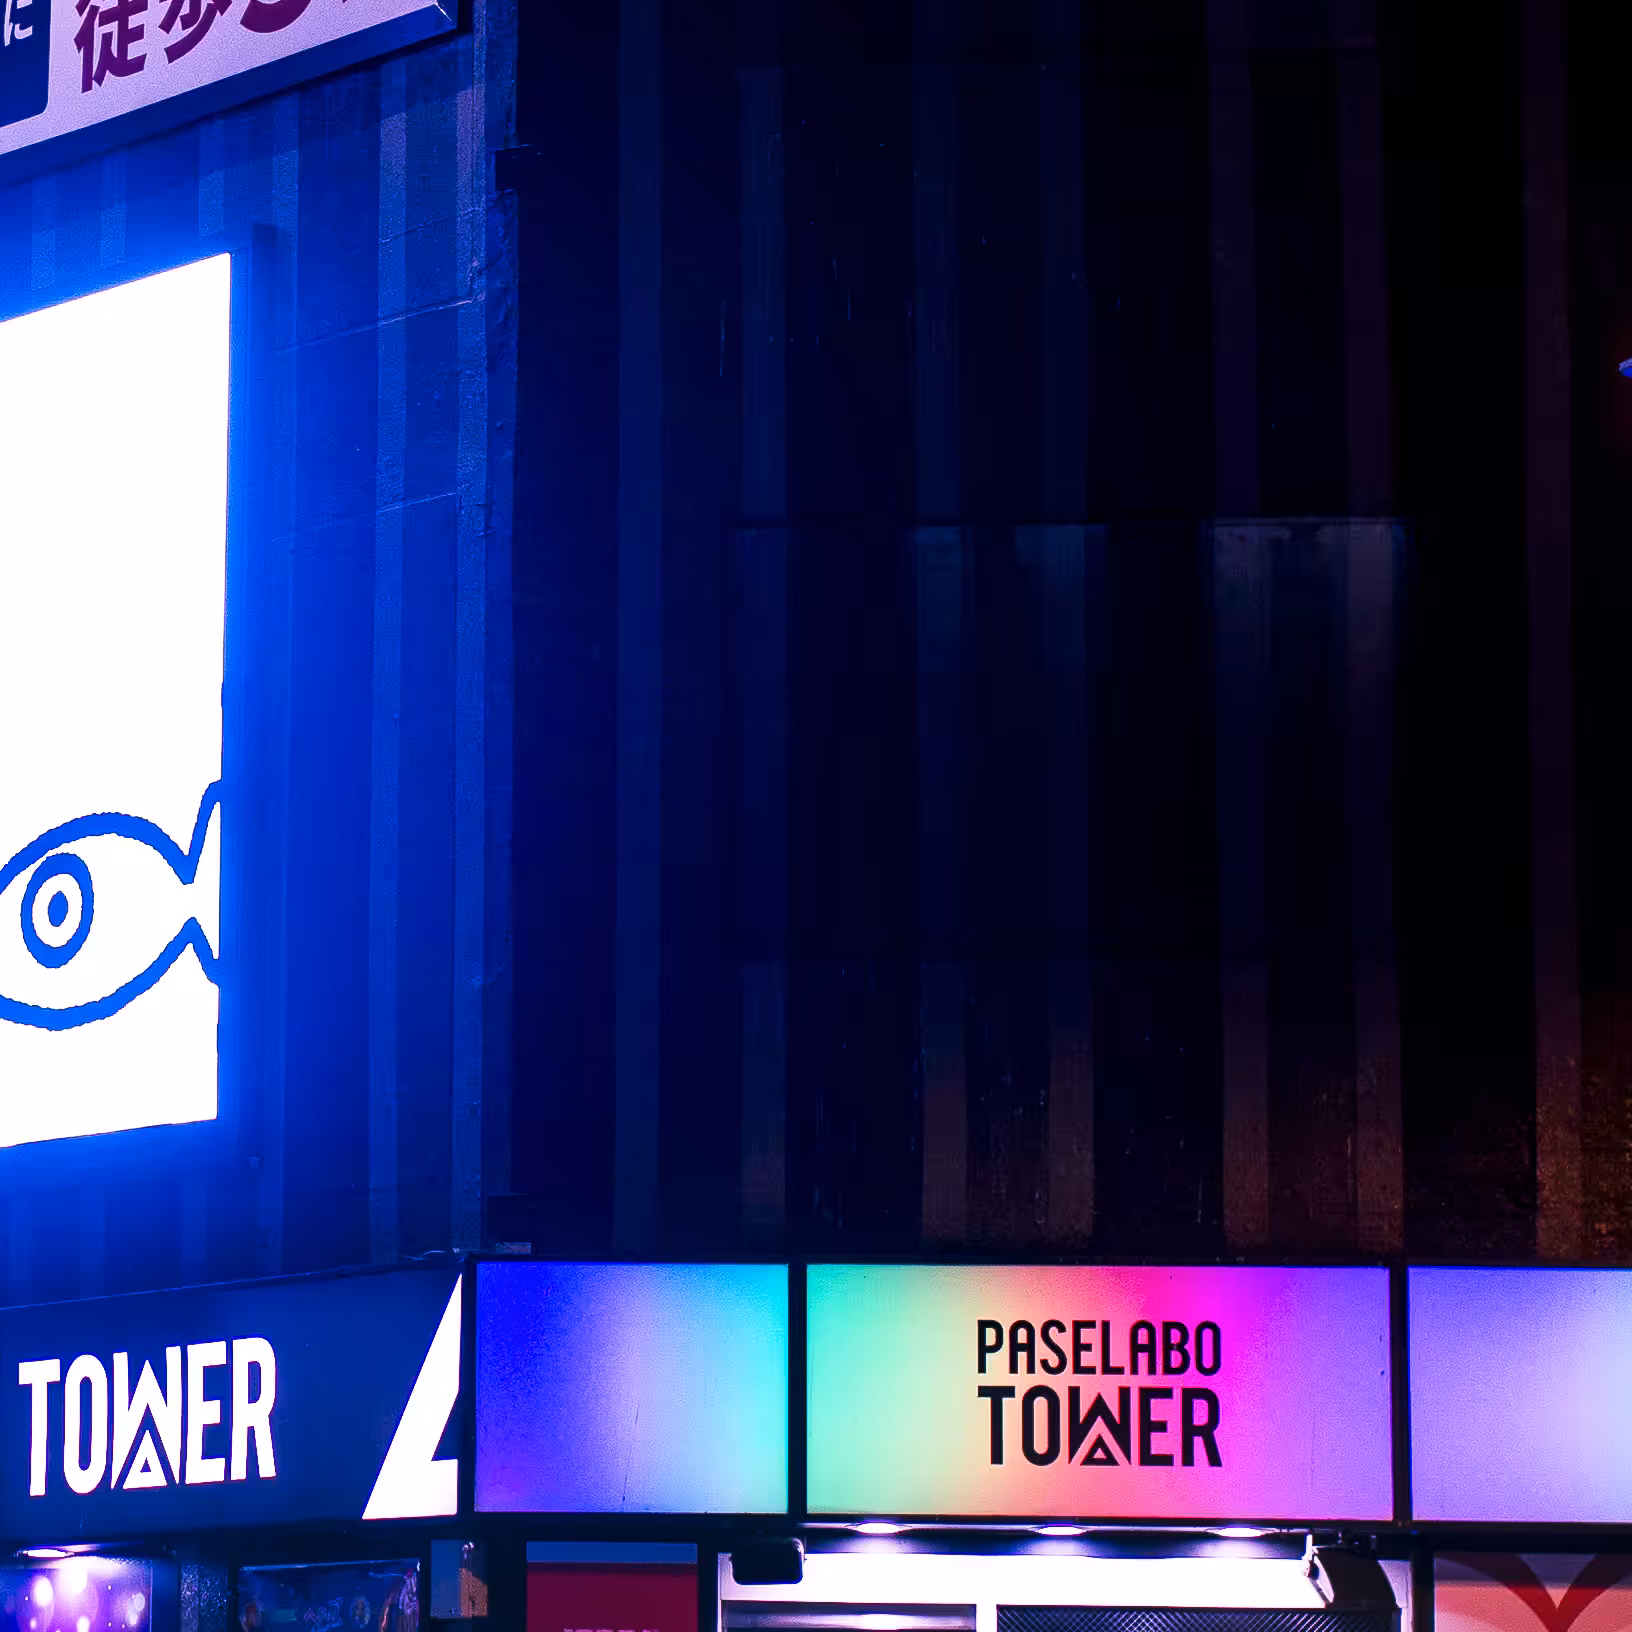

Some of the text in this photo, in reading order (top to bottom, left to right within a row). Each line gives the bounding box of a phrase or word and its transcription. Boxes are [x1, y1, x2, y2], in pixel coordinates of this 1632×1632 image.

[976, 1318, 1223, 1377] PASELABO
[18, 1336, 278, 1497] TOWER
[976, 1385, 1224, 1468] TOWER
